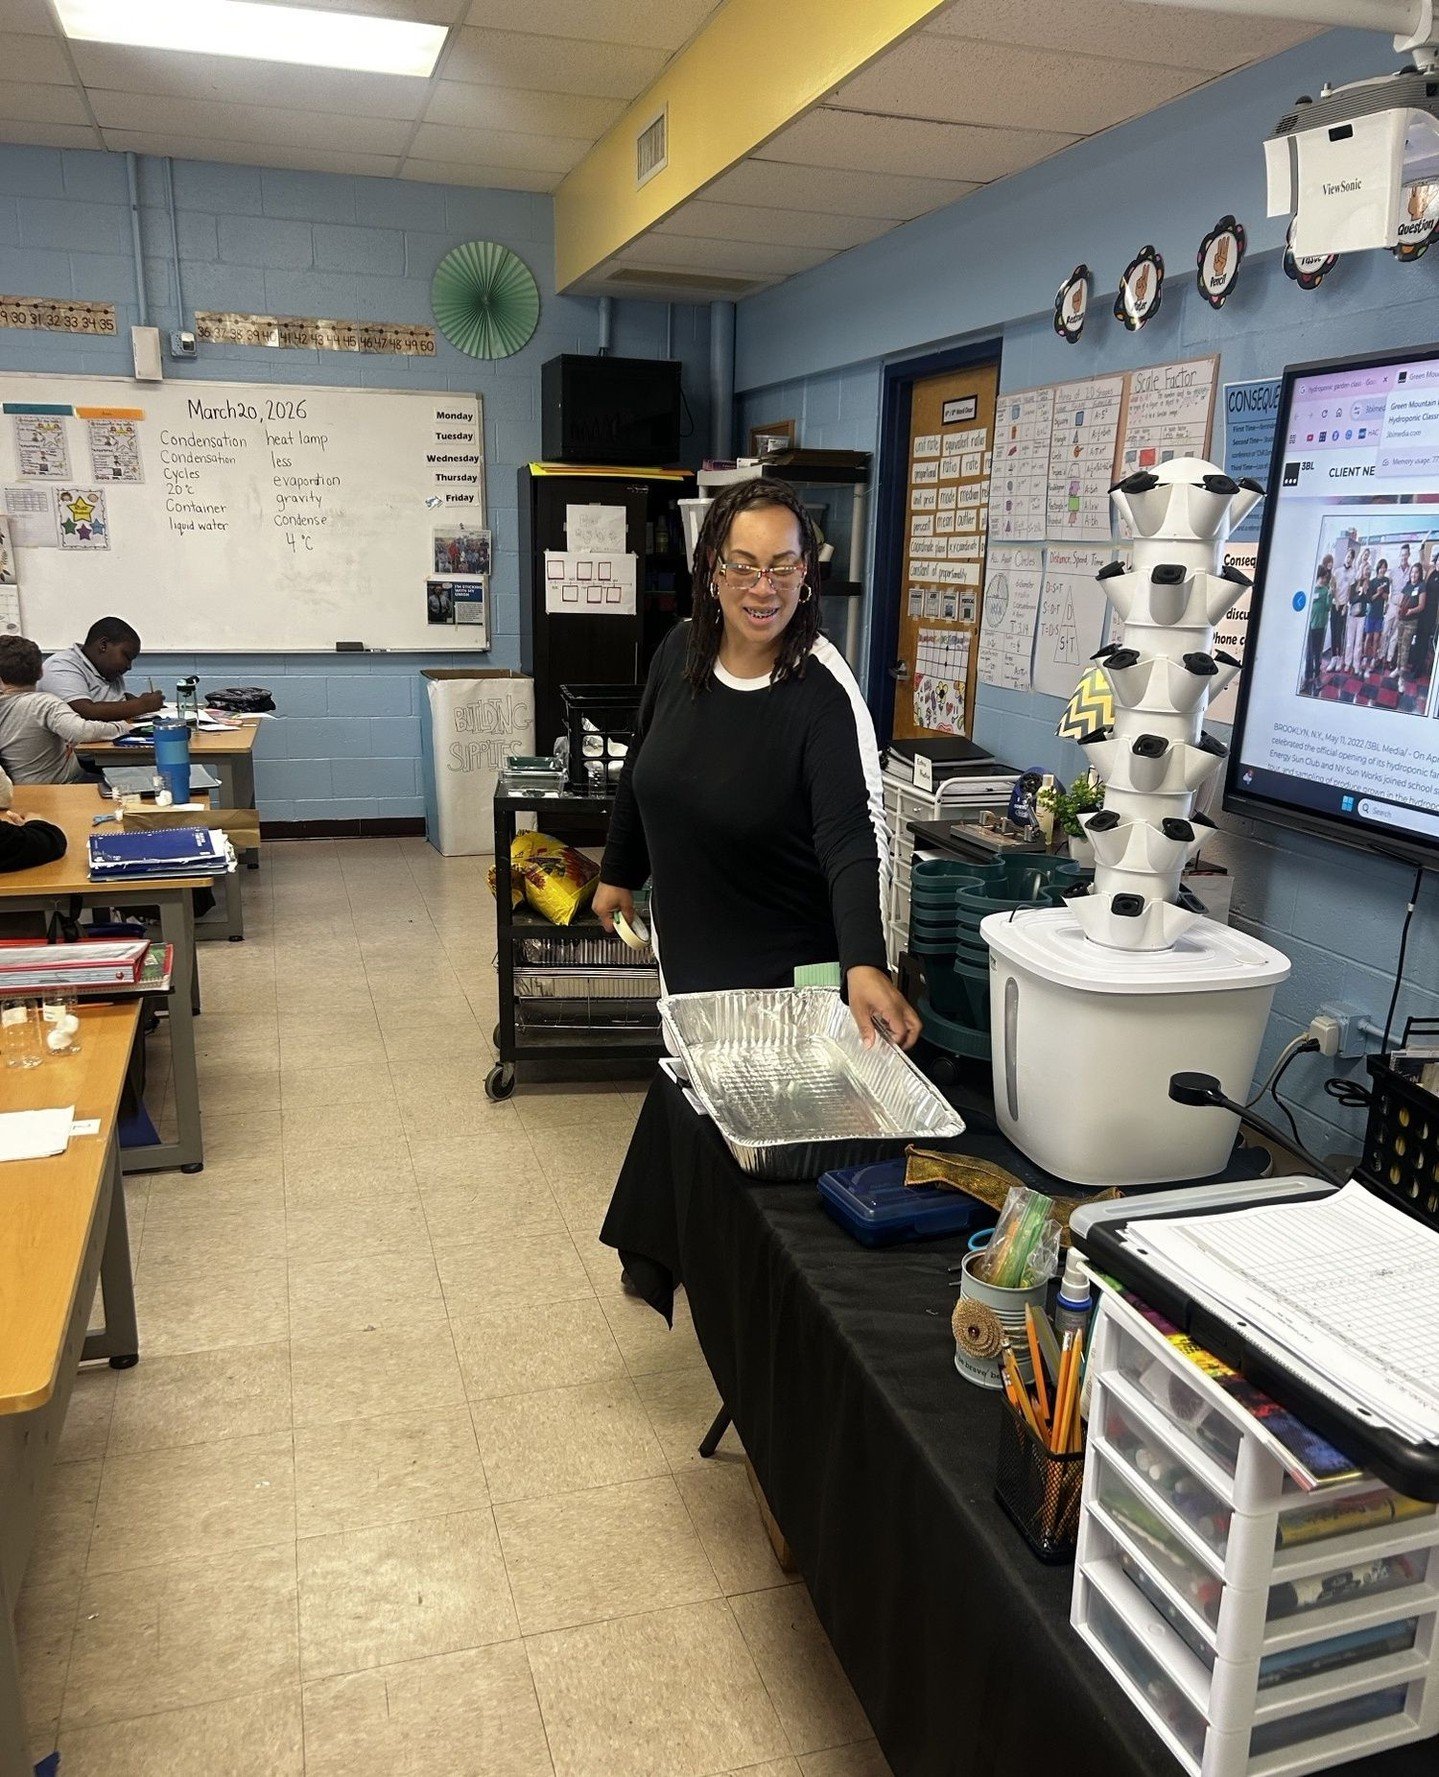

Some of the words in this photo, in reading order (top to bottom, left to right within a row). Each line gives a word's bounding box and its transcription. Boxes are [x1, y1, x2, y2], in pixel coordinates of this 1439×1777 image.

[1322, 178, 1362, 196] ViewSonic
[1398, 218, 1434, 236] Question
[11, 311, 27, 324] 30
[30, 313, 42, 326] 31
[46, 314, 60, 327] 32
[64, 316, 79, 328] 33
[82, 316, 97, 331] 34
[99, 318, 114, 331] 35
[198, 326, 211, 338] 36
[213, 328, 226, 339] 37
[229, 329, 243, 340] 38
[246, 329, 260, 342] 39
[262, 330, 276, 342] 40
[279, 331, 292, 344] 41
[294, 333, 307, 345] 42
[310, 333, 325, 346] 43
[326, 334, 341, 346] 44
[343, 334, 357, 347] 45
[360, 335, 373, 348] 46
[374, 335, 388, 349] 47
[389, 336, 402, 350] 48
[404, 336, 418, 350] 49
[1134, 369, 1159, 394] Scale
[1165, 366, 1197, 390] Factor
[1409, 372, 1425, 381] Green
[266, 399, 308, 421] 2026
[1390, 402, 1407, 411] Green
[1409, 400, 1436, 409] Mountain
[435, 411, 474, 422] Monday
[1388, 415, 1420, 426] Hydroponic
[160, 430, 248, 449] Condensation
[265, 429, 294, 446] heat
[299, 430, 329, 451] lamp
[435, 432, 474, 442] Tuesday
[160, 449, 236, 465] Condensation
[271, 451, 292, 468] less
[426, 454, 479, 464] Wednesday
[1392, 458, 1413, 467] Memory
[1301, 461, 1315, 471] 3BL
[1328, 466, 1361, 478] CLIENT
[1362, 466, 1376, 476] NE
[163, 468, 200, 484] Cycles
[435, 473, 478, 483] Thursday
[165, 498, 227, 514] Container
[276, 490, 322, 512] gravity
[445, 493, 475, 503] Friday
[169, 516, 195, 536] liquid
[199, 518, 229, 531] water
[286, 532, 296, 553] 4
[1091, 553, 1103, 566] Time
[1223, 553, 1256, 569] Conseq
[453, 694, 533, 735] BUILDING
[1325, 733, 1339, 745] May
[1347, 737, 1365, 749] 2022
[1271, 737, 1304, 750] celebrated
[1304, 743, 1316, 753] the
[1316, 746, 1338, 757] official
[1338, 751, 1367, 766] opening
[1368, 757, 1376, 765] of
[1376, 760, 1386, 768] its
[1386, 760, 1429, 778] hydroponic
[1269, 749, 1291, 762] Energy
[1292, 754, 1304, 763] Sun
[1305, 757, 1320, 768] Club
[1320, 762, 1334, 771] and
[1335, 764, 1346, 772] NY
[1345, 766, 1360, 777] Sun
[1361, 769, 1383, 782] Works
[1382, 776, 1407, 788] joined
[1407, 781, 1433, 793] school
[1395, 793, 1409, 802] the
[1372, 808, 1392, 818] Search
